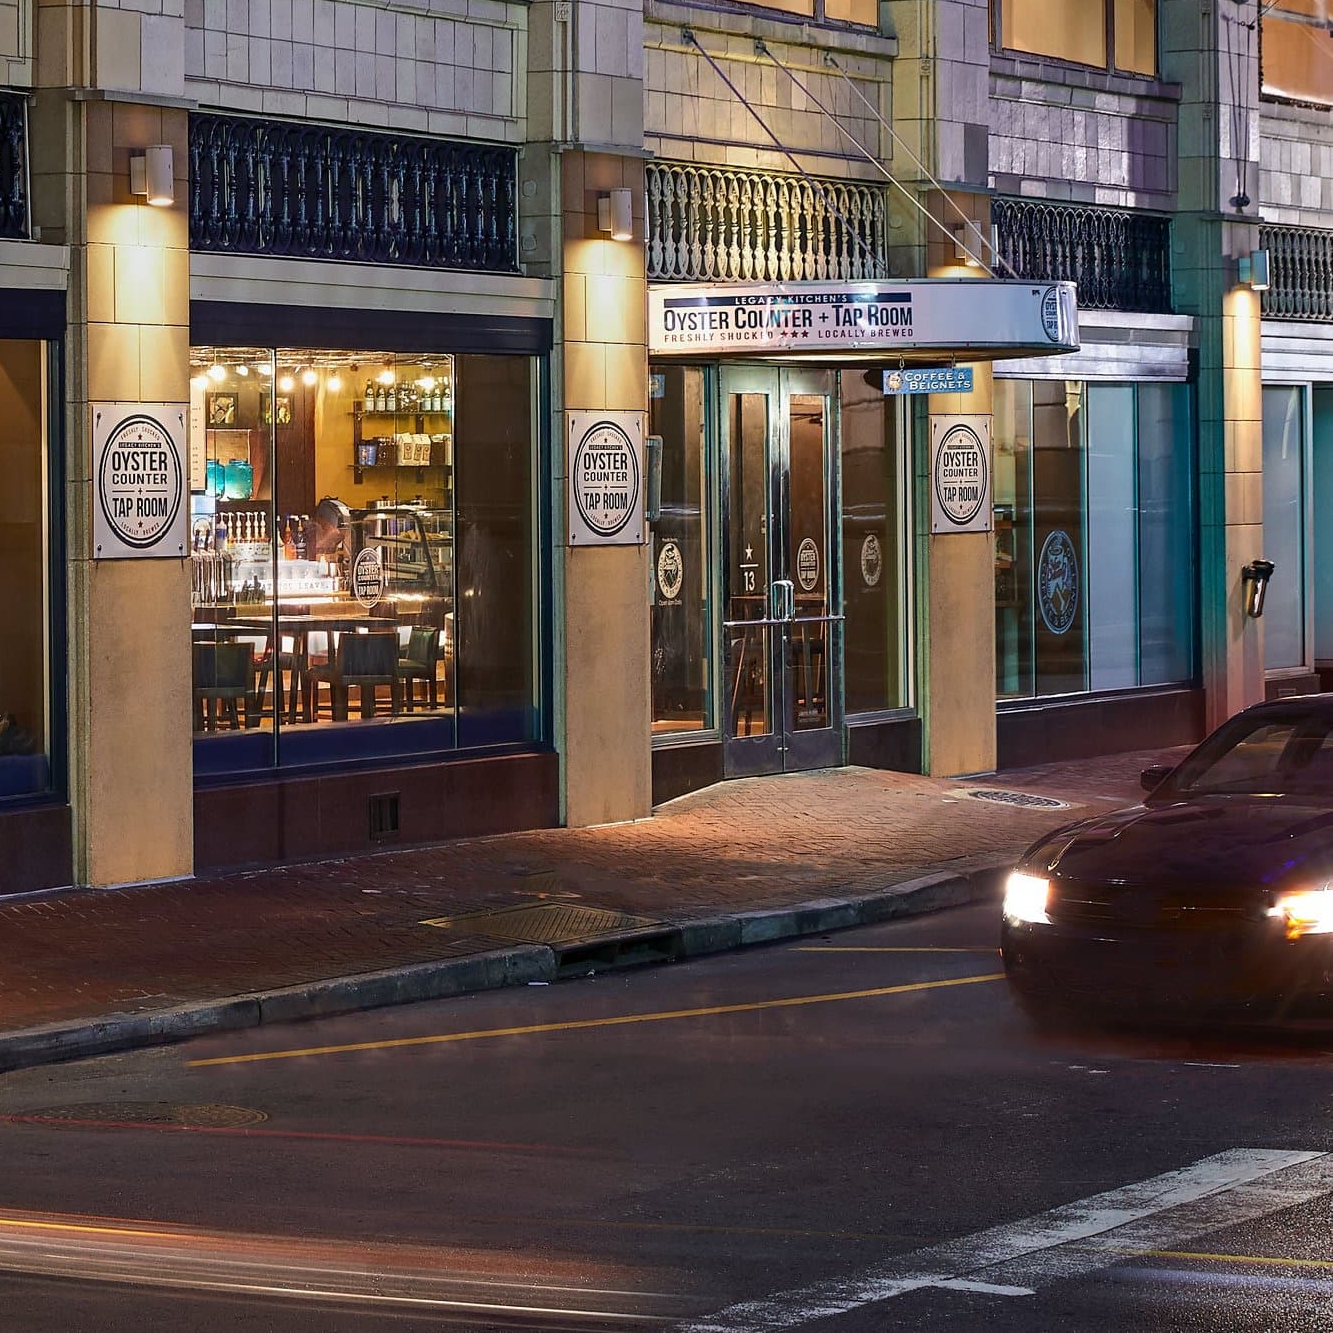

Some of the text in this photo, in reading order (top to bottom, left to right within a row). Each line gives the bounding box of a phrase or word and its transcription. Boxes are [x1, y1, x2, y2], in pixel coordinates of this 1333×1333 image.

[787, 295, 847, 303] KITCHEN'S
[664, 309, 729, 331] OYSTER
[735, 307, 813, 329] COUNTER
[832, 305, 863, 326] TAP
[867, 304, 913, 326] ROOM
[664, 333, 715, 343] FRESHLY
[818, 329, 865, 339] LOCALLY
[870, 328, 913, 338] BREWED
[904, 372, 953, 382] COFFEE
[909, 380, 971, 390] BEIGNETS
[112, 451, 167, 471] OYSTER
[584, 452, 628, 470] OYSTER
[943, 451, 978, 467] OYSTER
[112, 473, 167, 485] COUNTER
[584, 471, 628, 482] COUNTER
[943, 468, 978, 477] COUNTER
[584, 493, 628, 510] TAP ROOM
[943, 486, 978, 502] TAP ROOM
[112, 497, 167, 517] TAP ROOM
[743, 571, 755, 591] 13
